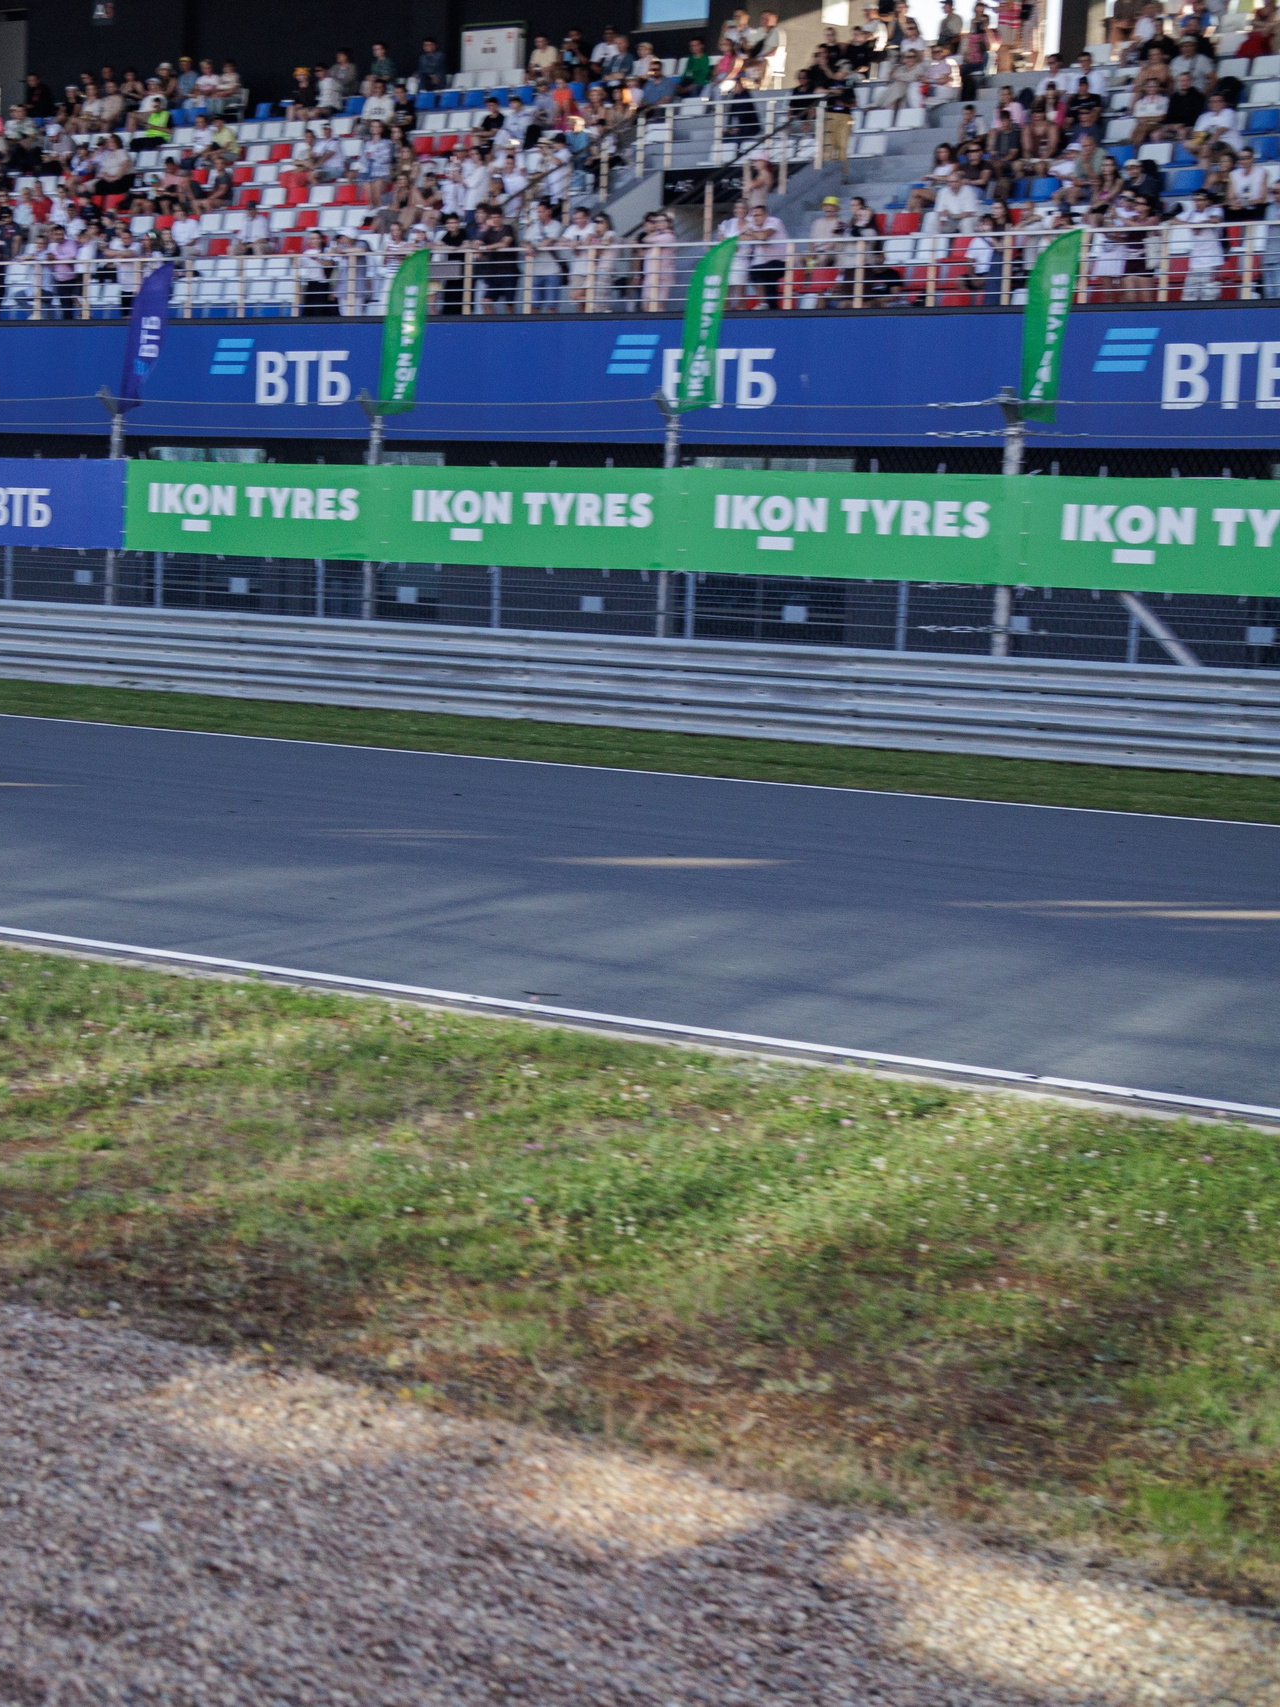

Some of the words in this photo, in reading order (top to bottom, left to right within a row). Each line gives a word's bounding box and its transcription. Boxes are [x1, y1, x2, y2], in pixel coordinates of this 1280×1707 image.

[138, 315, 161, 358] ВТБ
[255, 350, 351, 406] ВТБ
[147, 482, 237, 517] IKON
[245, 486, 361, 521] TYRES
[411, 489, 513, 525] IKON
[523, 491, 654, 528] TYRES
[713, 494, 829, 533] IKON
[841, 498, 991, 539] TYRES
[1060, 503, 1197, 546] IKON
